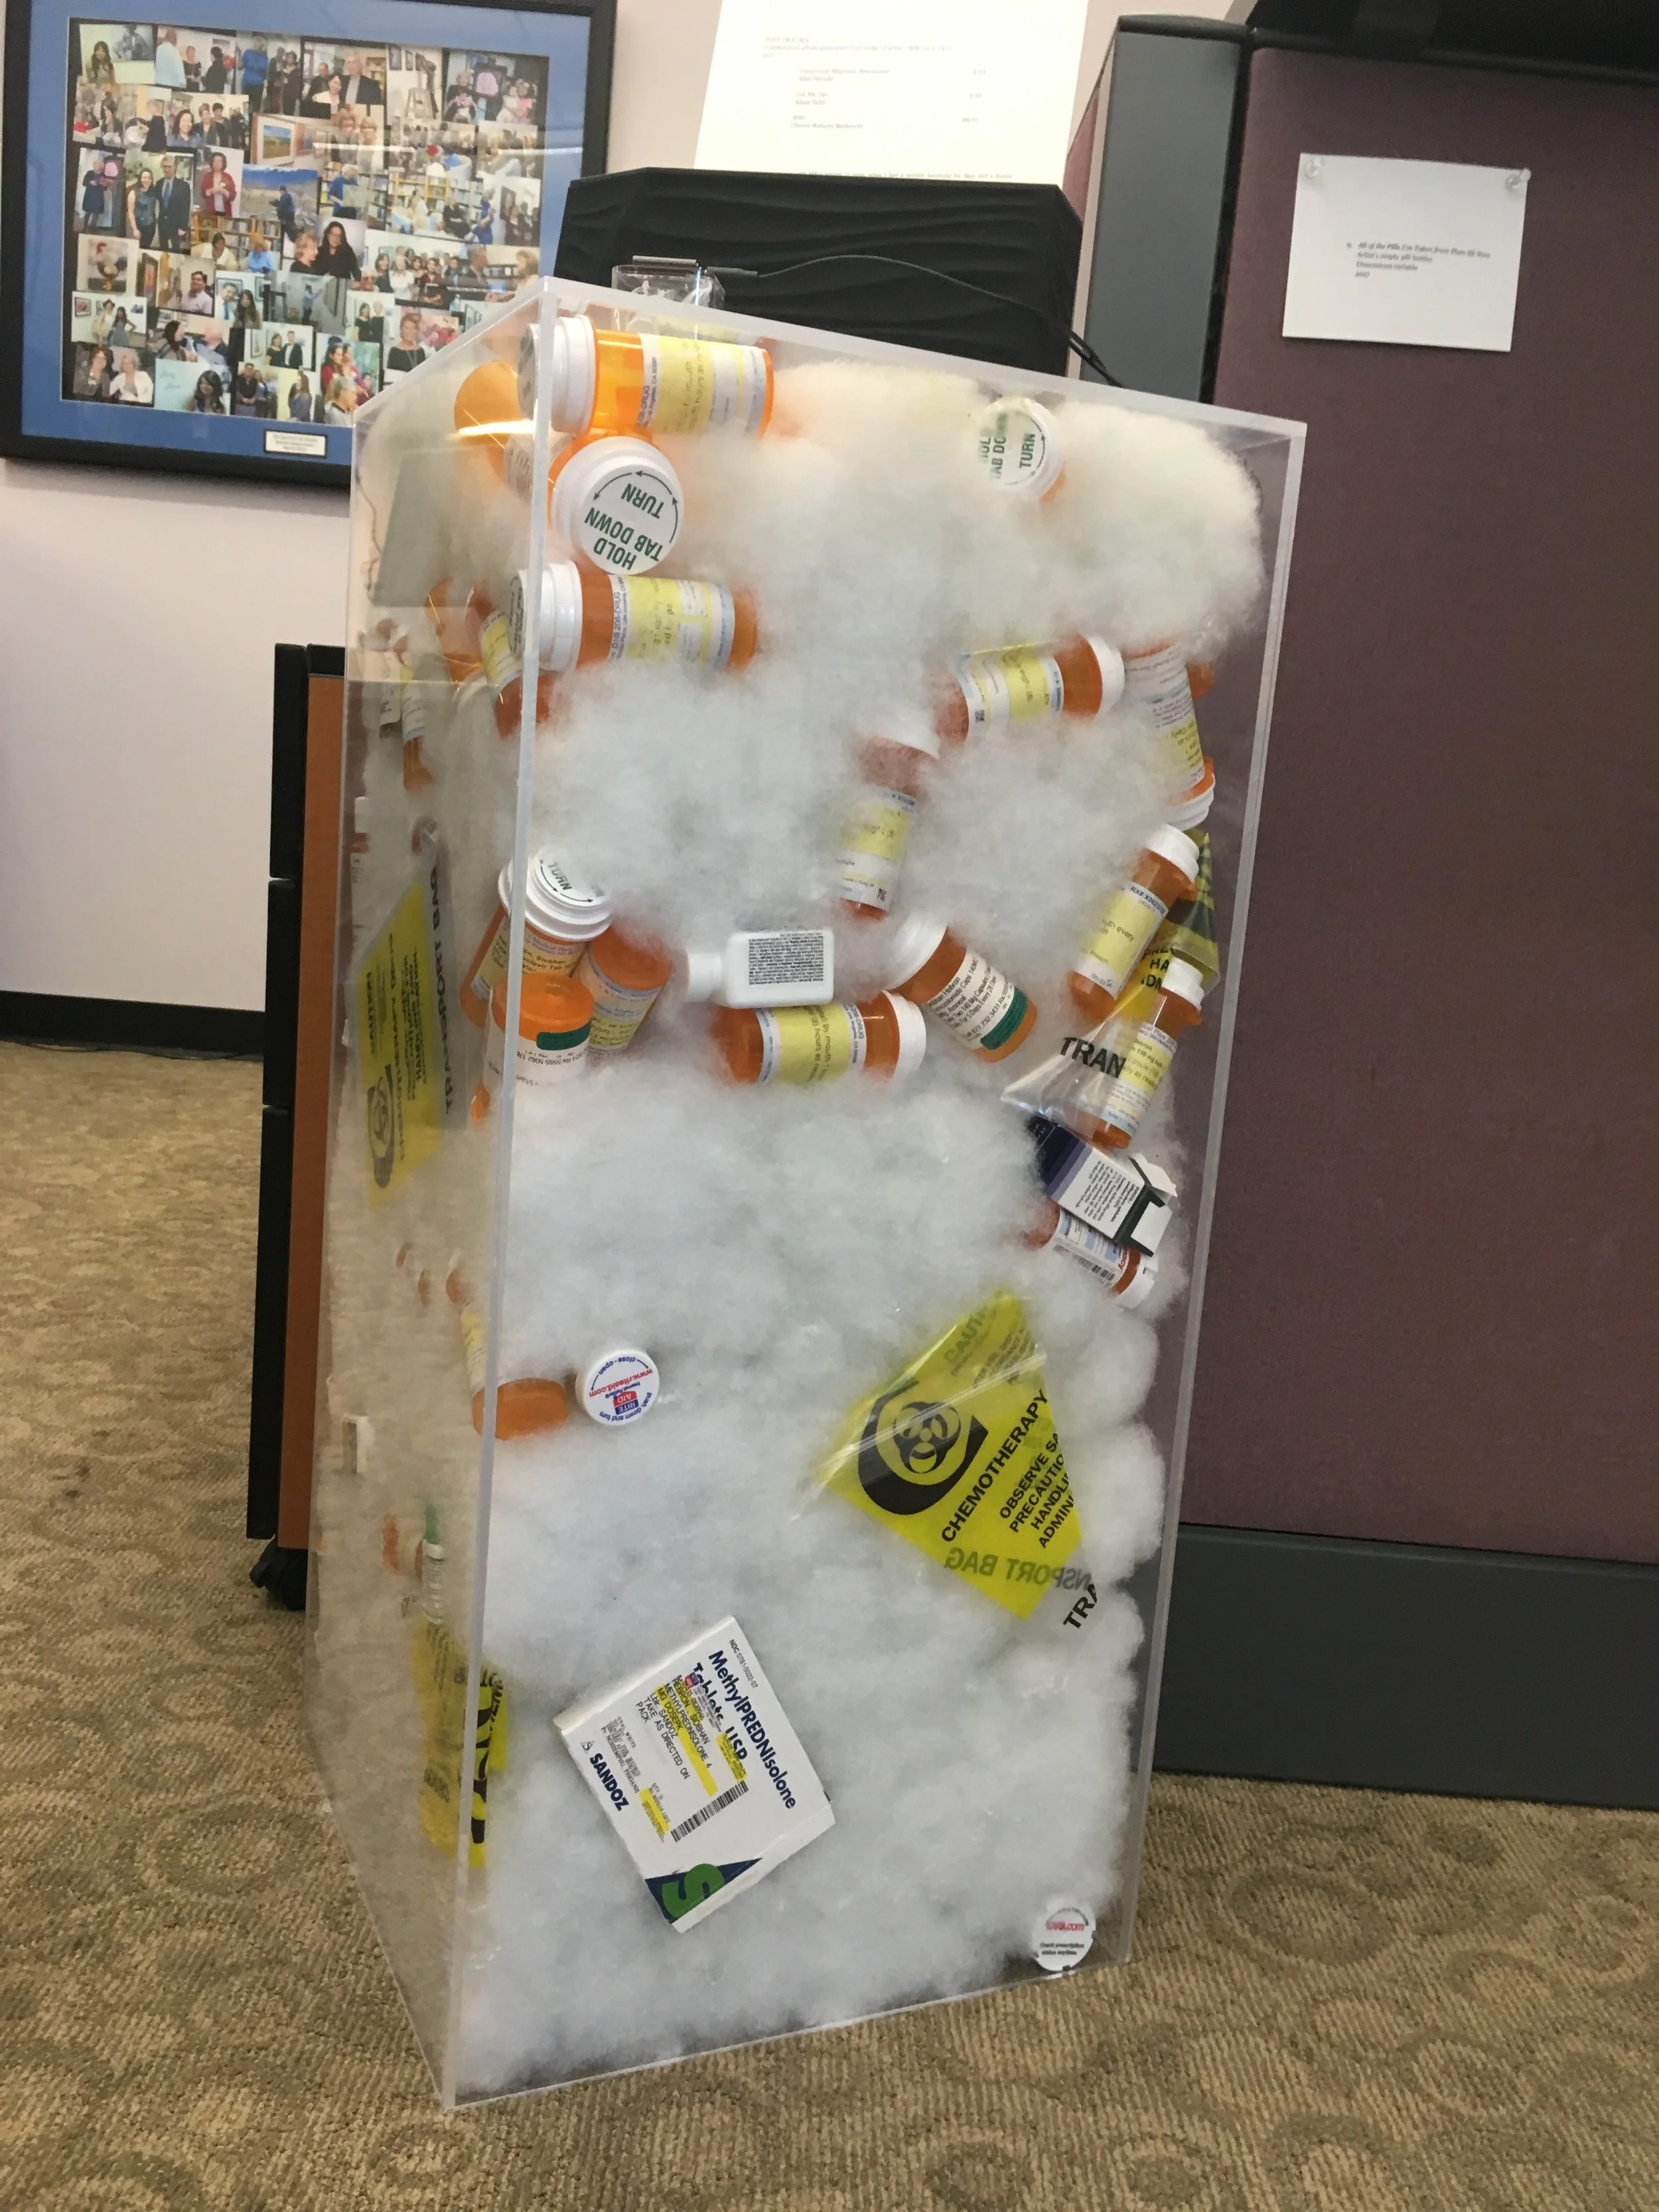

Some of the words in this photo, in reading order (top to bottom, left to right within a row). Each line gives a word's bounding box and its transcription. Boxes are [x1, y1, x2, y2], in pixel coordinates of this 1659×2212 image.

[1019, 432, 1037, 469] TURN
[620, 482, 664, 519] TURN
[585, 506, 635, 545] DOWN
[594, 536, 637, 571] HOLD
[634, 536, 664, 561] TAB
[547, 859, 573, 893] TURN
[1114, 925, 1135, 942] every
[940, 974, 961, 995] Hebron
[958, 973, 974, 989] Caps
[977, 990, 991, 1005] Every
[814, 1027, 822, 1051] hours
[1060, 1037, 1126, 1078] TRAN
[598, 1361, 614, 1375] open
[589, 1368, 653, 1398] www.riteaid.com
[617, 1393, 632, 1403] AID
[618, 1401, 636, 1413] RITE
[640, 1392, 653, 1408] push
[599, 1410, 611, 1421] turn
[624, 1407, 642, 1420] down
[941, 1389, 1048, 1542] CHEMOTHERAPY
[999, 1455, 1049, 1518] OBSERVE
[728, 1638, 741, 1654] NDC
[634, 1701, 651, 1723] PACK
[642, 1696, 658, 1718] TAKE
[656, 1688, 668, 1701] MG
[664, 1701, 684, 1730] DOSEPK
[670, 1678, 691, 1708] HEBRON
[688, 1712, 711, 1745] SIOBHAN
[654, 1719, 665, 1732] AS
[657, 1708, 678, 1739] SANDOZ
[661, 1682, 710, 1761] METHYLPREDNISOLONE
[707, 1649, 797, 1810] MethylPREDNIsolone
[659, 1732, 684, 1767] DIRECTED
[588, 1751, 630, 1812] SANDOZ
[679, 1767, 690, 1780] ON
